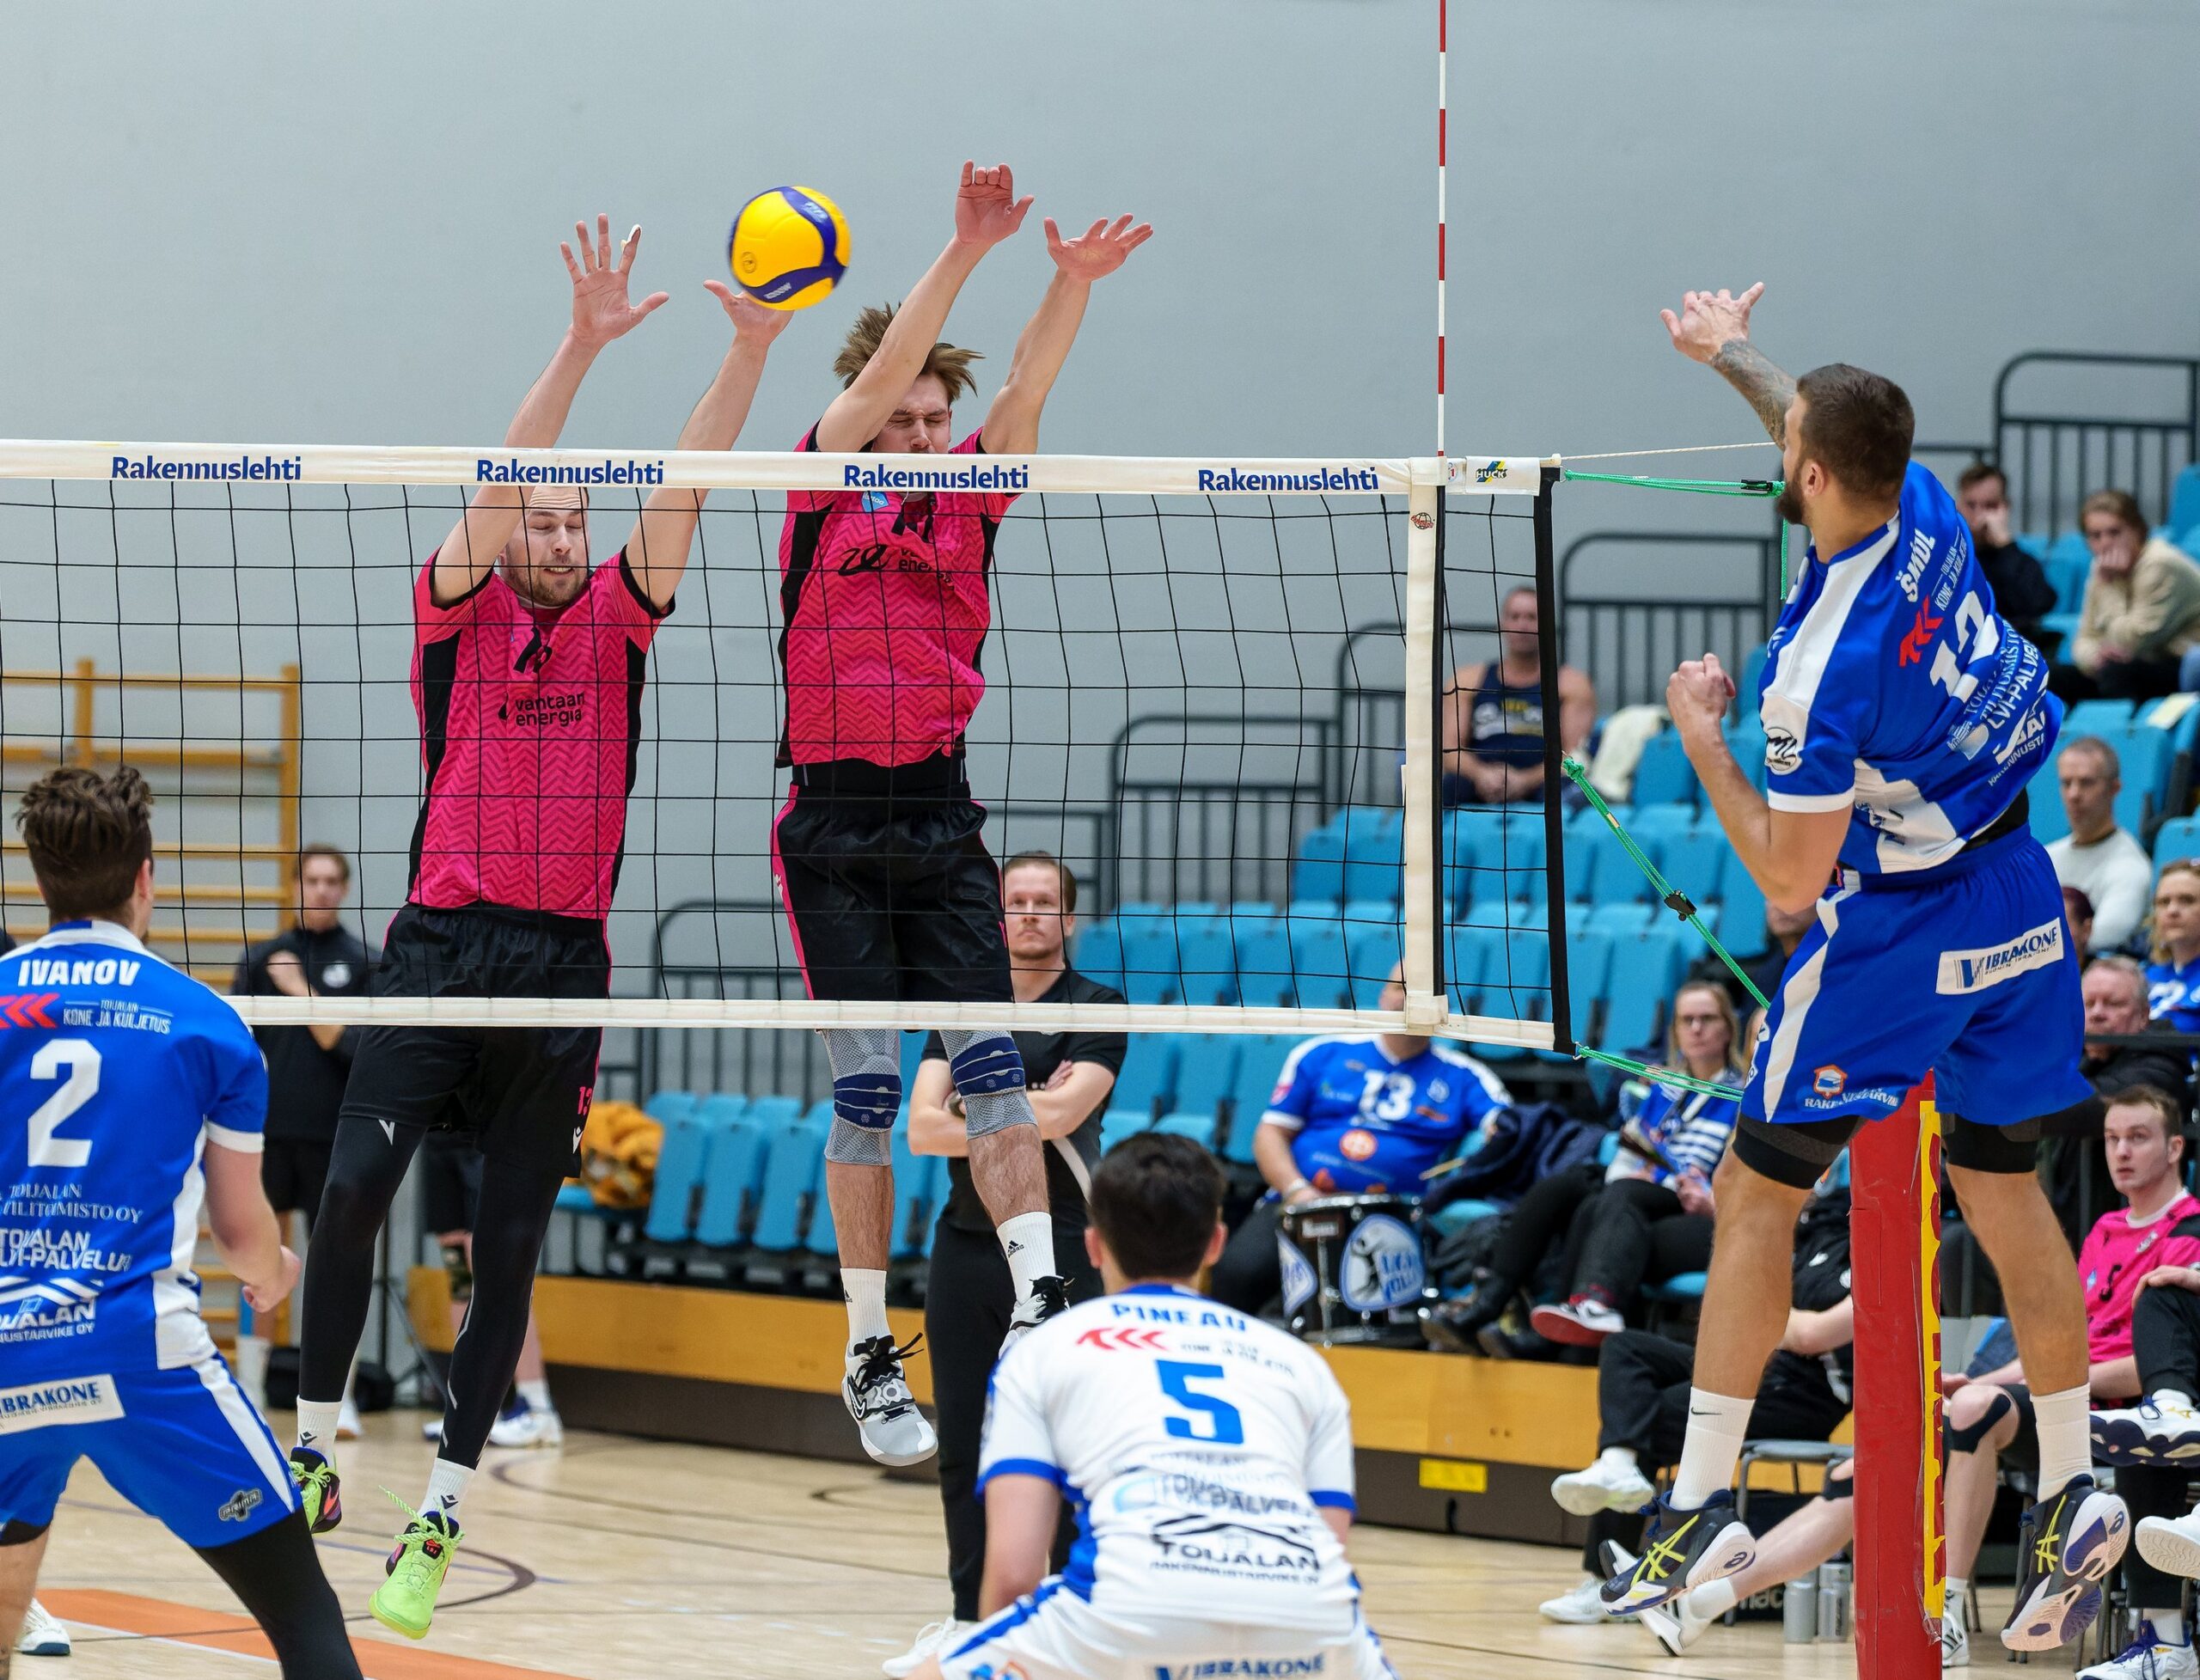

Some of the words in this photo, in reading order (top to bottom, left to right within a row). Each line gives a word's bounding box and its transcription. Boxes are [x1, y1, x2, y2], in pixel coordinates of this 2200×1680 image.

[113, 455, 301, 480] Rakennuslehti
[477, 459, 663, 484] Rakennuslehti
[844, 463, 1028, 489] Rakennuslehti
[1199, 467, 1378, 492] Rakennuslehti
[1476, 467, 1507, 480] HUCK
[516, 691, 586, 712] vantaan
[516, 708, 583, 727] energia
[18, 959, 141, 987] IVANOV
[64, 1008, 93, 1027] KONE
[95, 1011, 112, 1027] JA
[113, 1011, 171, 1035] KULJETUS
[28, 1038, 102, 1167] 2
[1359, 1068, 1417, 1121] 13
[115, 1207, 144, 1224] OY
[1111, 1303, 1246, 1332] PINEAU
[1155, 1359, 1244, 1445] 5
